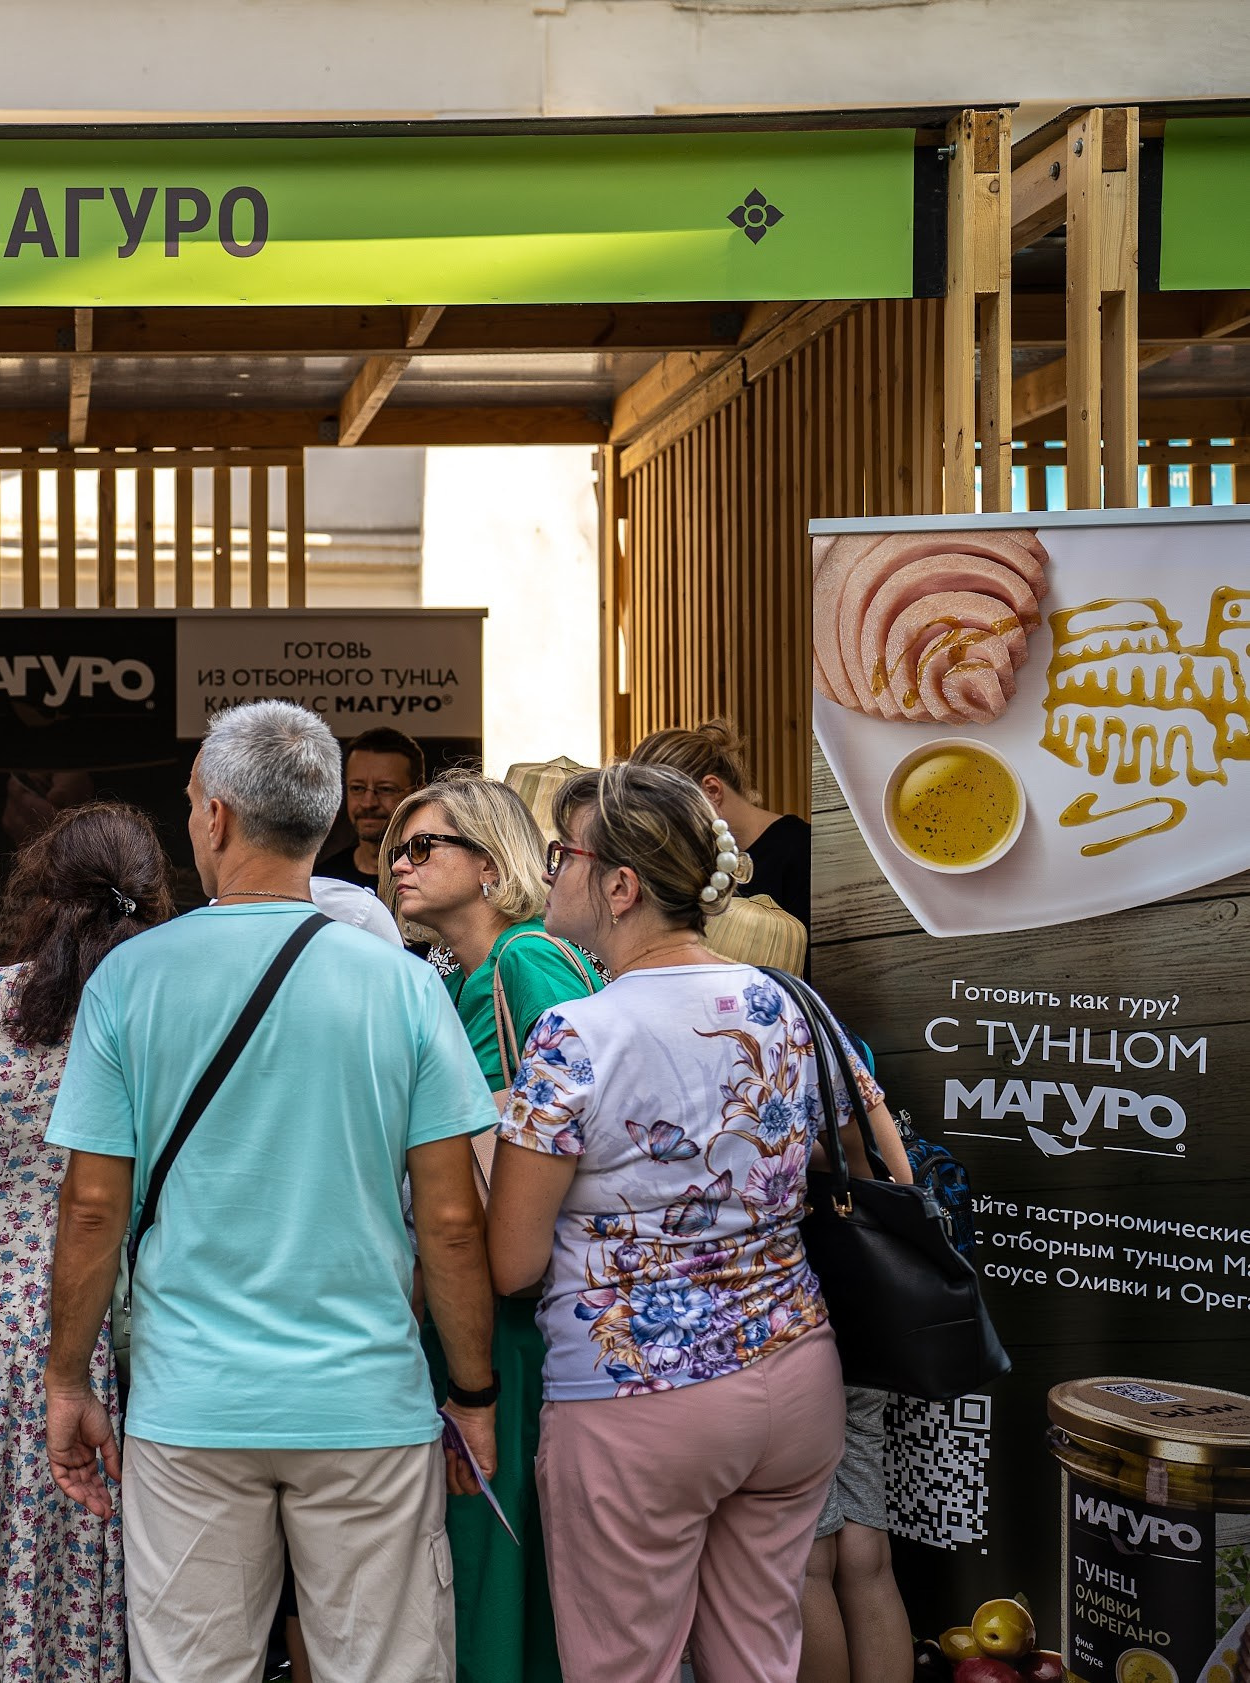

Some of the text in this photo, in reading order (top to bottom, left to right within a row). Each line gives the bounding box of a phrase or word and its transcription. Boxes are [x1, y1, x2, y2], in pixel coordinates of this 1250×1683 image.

[284, 641, 371, 659] ГОТОВЬ
[198, 668, 458, 689] ИЗ ОТБОРНОГО ТУНЦА
[312, 696, 328, 712] С
[950, 979, 1181, 1020] Готовить как гуру?
[925, 1017, 1207, 1074] С ТУНЦОМ
[944, 1078, 1187, 1139] МАГУРО
[971, 1194, 1250, 1244] айте гастрономические
[992, 1231, 1114, 1260] отборным
[1123, 1247, 1213, 1272] тунцом
[984, 1263, 1047, 1286] соусе
[1057, 1268, 1147, 1297] Оливки
[1156, 1286, 1171, 1300] и
[1075, 1494, 1202, 1551] МАГУРО
[1075, 1556, 1138, 1599] ТУНЕЦ
[1075, 1583, 1141, 1621] ОЛИВКИ
[1075, 1601, 1171, 1646] И ОРЕГАНО
[1075, 1633, 1094, 1651] филе
[1080, 1652, 1103, 1668] соусе
